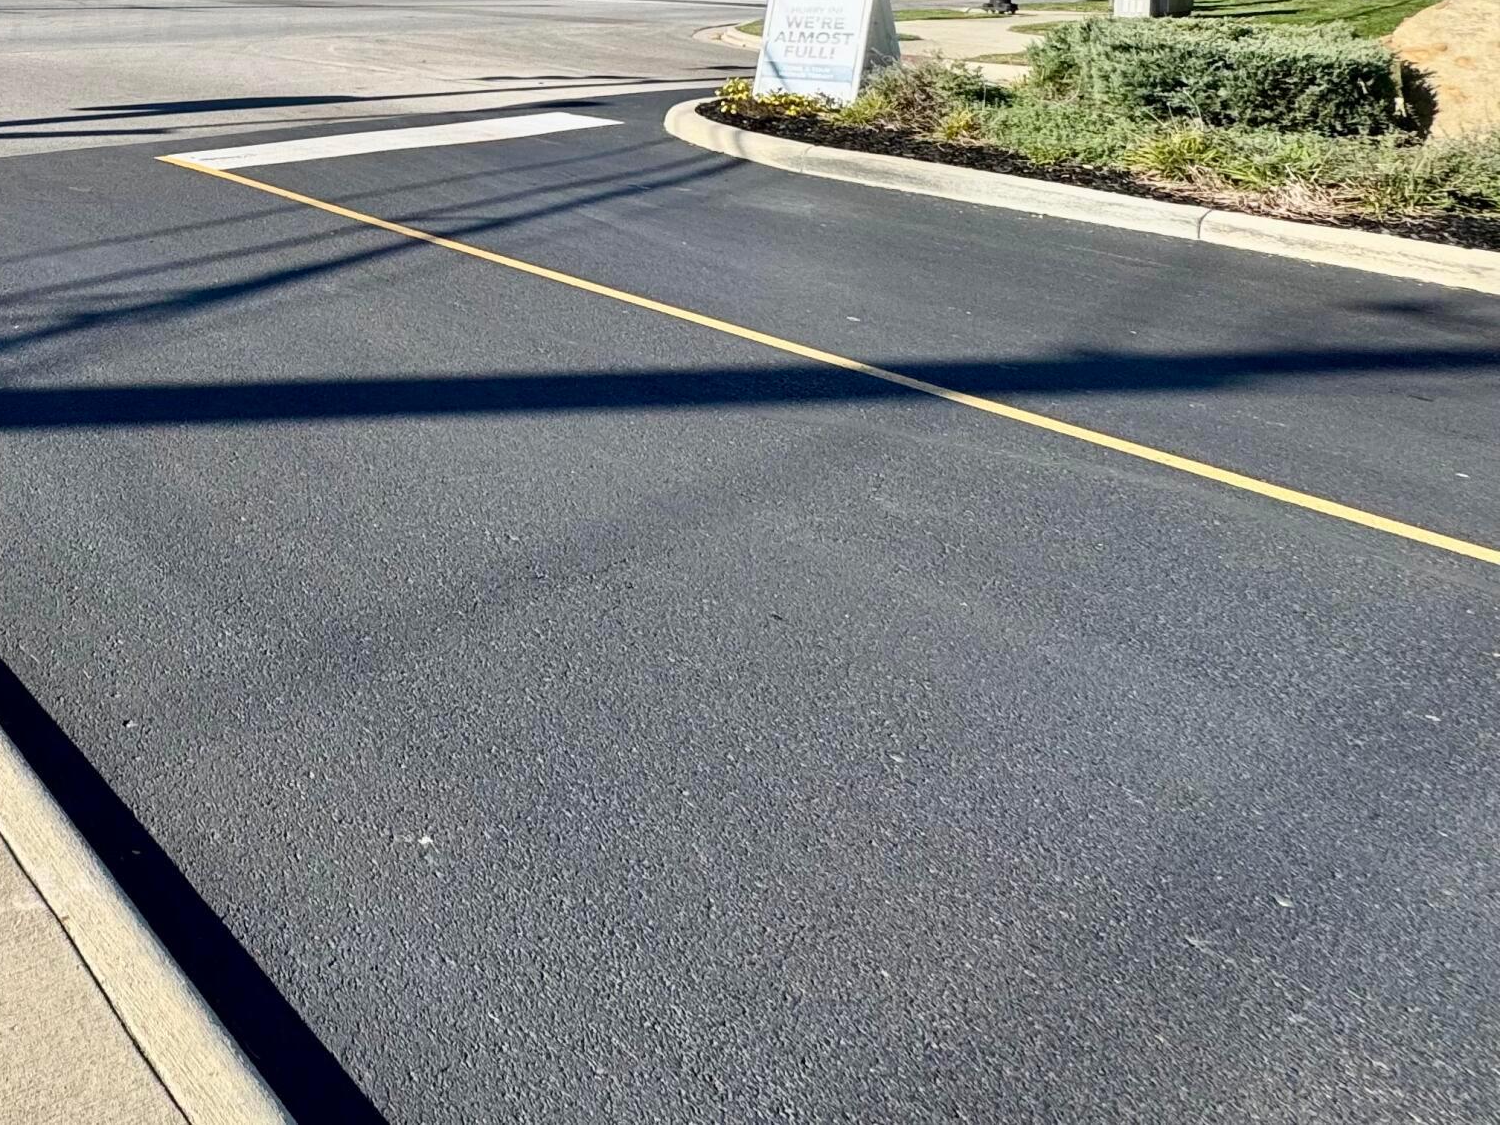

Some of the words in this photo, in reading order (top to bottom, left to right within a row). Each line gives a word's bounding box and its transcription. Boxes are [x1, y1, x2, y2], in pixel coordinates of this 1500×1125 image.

[786, 15, 845, 30] WE'RE
[774, 31, 854, 45] ALMOST
[784, 46, 836, 60] FULL!
